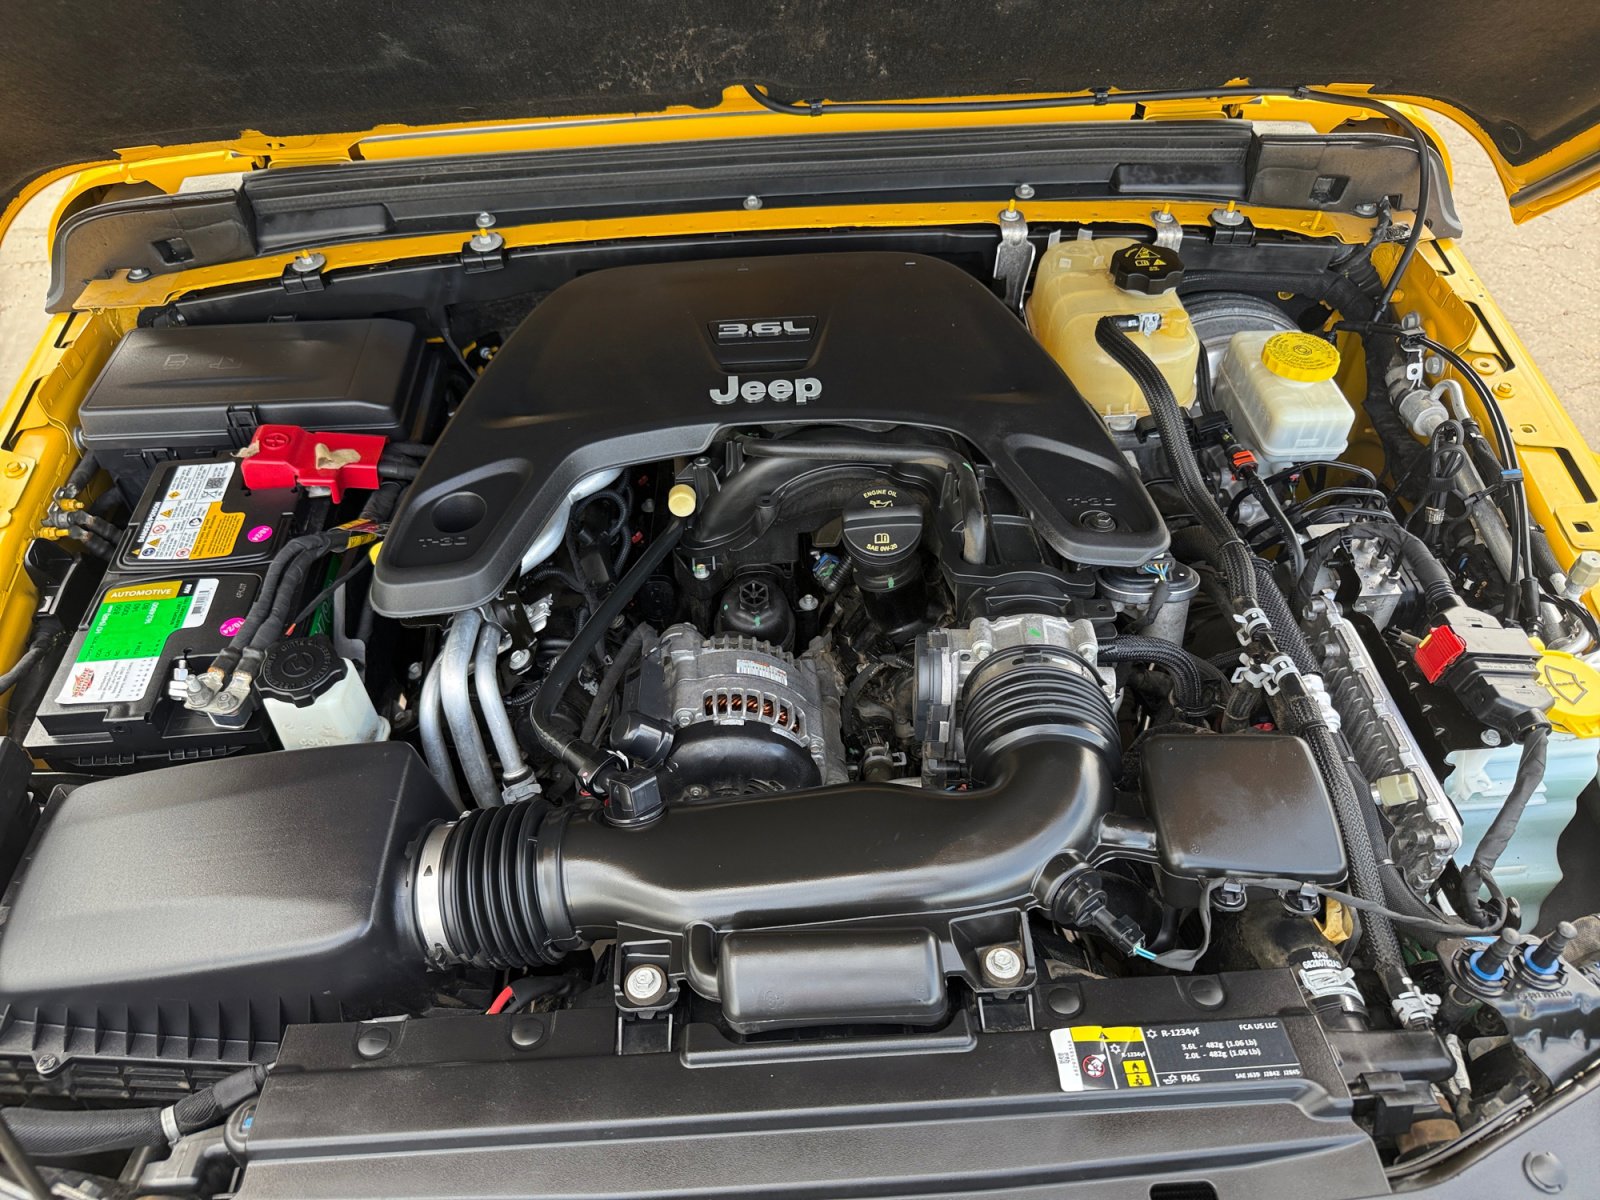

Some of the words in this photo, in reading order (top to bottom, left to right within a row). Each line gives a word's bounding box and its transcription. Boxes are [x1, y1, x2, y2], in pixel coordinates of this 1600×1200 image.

[718, 321, 810, 338] 3.6L
[709, 375, 822, 405] Jeep
[863, 489, 886, 499] ENGINE
[887, 489, 898, 498] OIL
[866, 543, 880, 552] SAE
[111, 587, 173, 598] AUTOMOTIVE
[1311, 951, 1328, 960] RAD
[1160, 1027, 1200, 1037] R-1234yf
[1205, 1041, 1225, 1049] 482g
[1226, 1040, 1244, 1048] (1.06
[1245, 1039, 1258, 1047] Lb)
[1209, 1050, 1228, 1058] 482g
[1229, 1049, 1248, 1057] (1.06
[1249, 1048, 1262, 1056] Lb)
[1180, 1073, 1201, 1082] PAG
